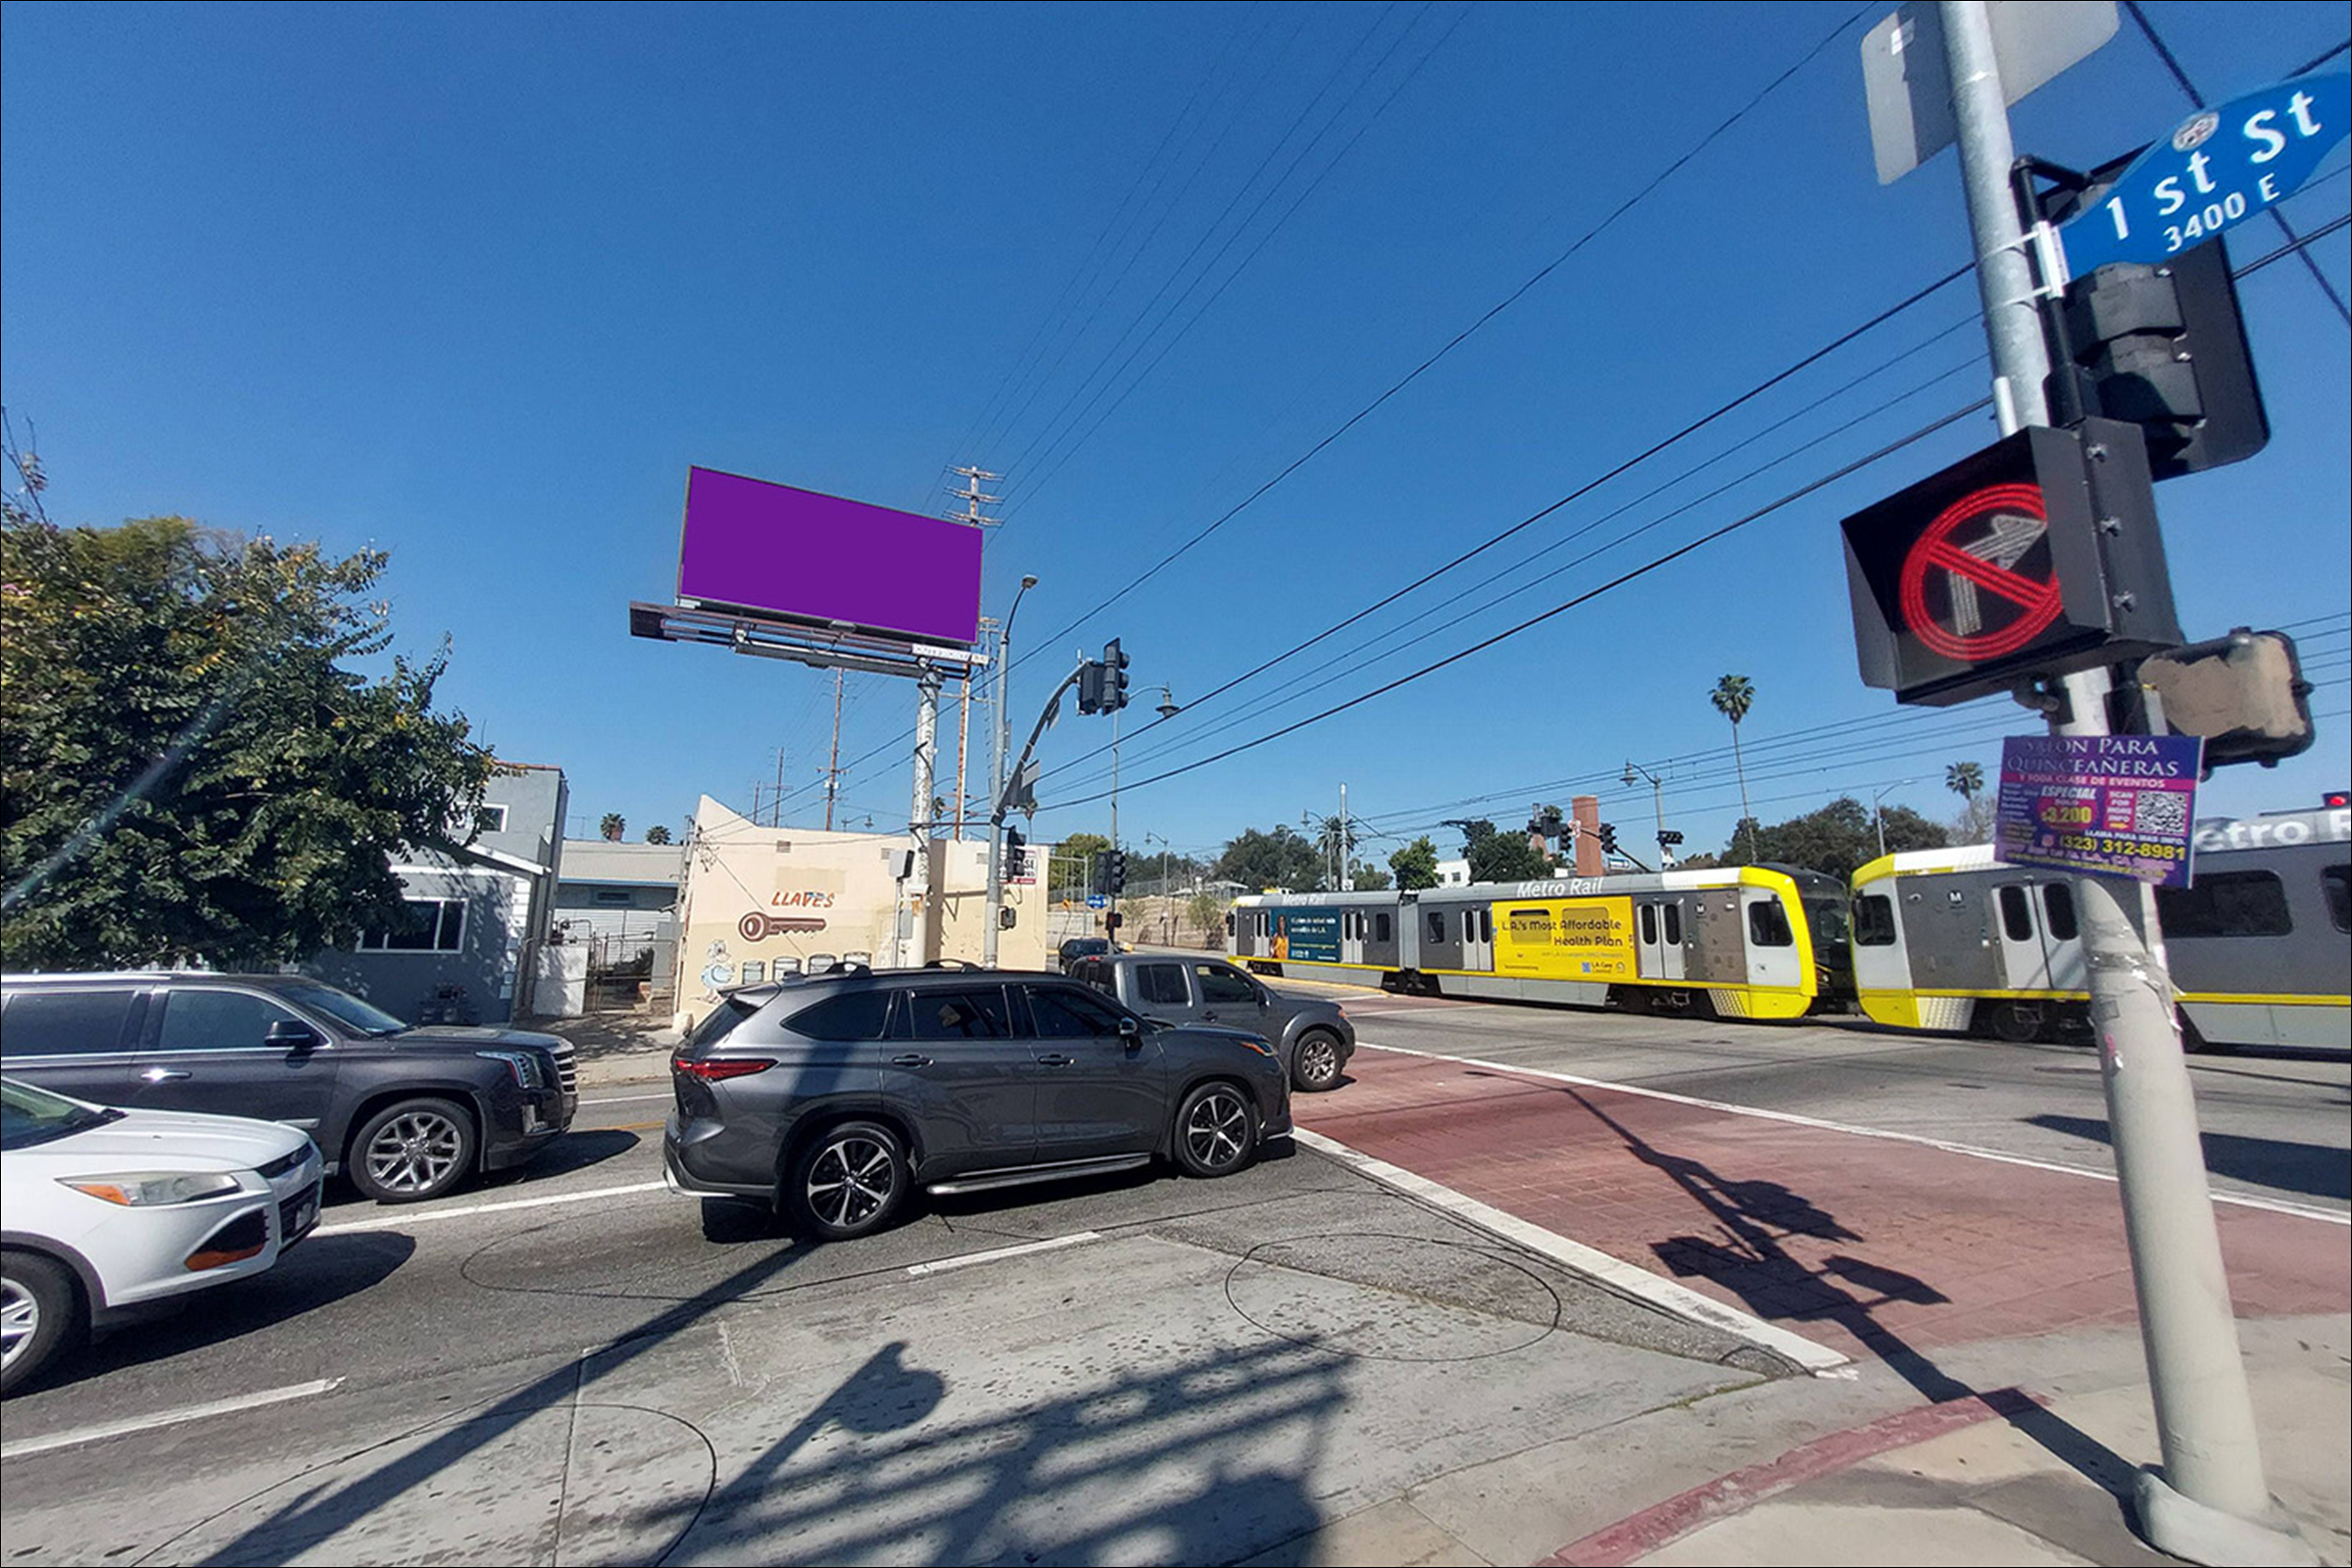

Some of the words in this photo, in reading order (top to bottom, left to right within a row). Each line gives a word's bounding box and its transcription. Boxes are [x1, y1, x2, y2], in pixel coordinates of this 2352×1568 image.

[2242, 90, 2322, 164] St
[2163, 192, 2246, 253] 3400
[2258, 172, 2280, 202] E
[2099, 738, 2159, 755] PARA
[2028, 774, 2053, 783] TODA
[2056, 775, 2086, 784] CLASE
[2090, 776, 2106, 785] DE
[2109, 777, 2166, 789] EVENTOS
[2040, 785, 2097, 800] ESPECIAL
[2195, 820, 2309, 851] etro
[2059, 835, 2097, 852] (323)
[2102, 839, 2186, 860] 312-8981
[1516, 880, 1566, 898] Metro
[1570, 877, 1604, 896] Rail
[771, 891, 835, 907] LLAVES
[1530, 921, 1557, 930] Most
[1560, 919, 1622, 930] Affordable
[1554, 935, 1592, 946] Health
[1595, 935, 1624, 947] Plan
